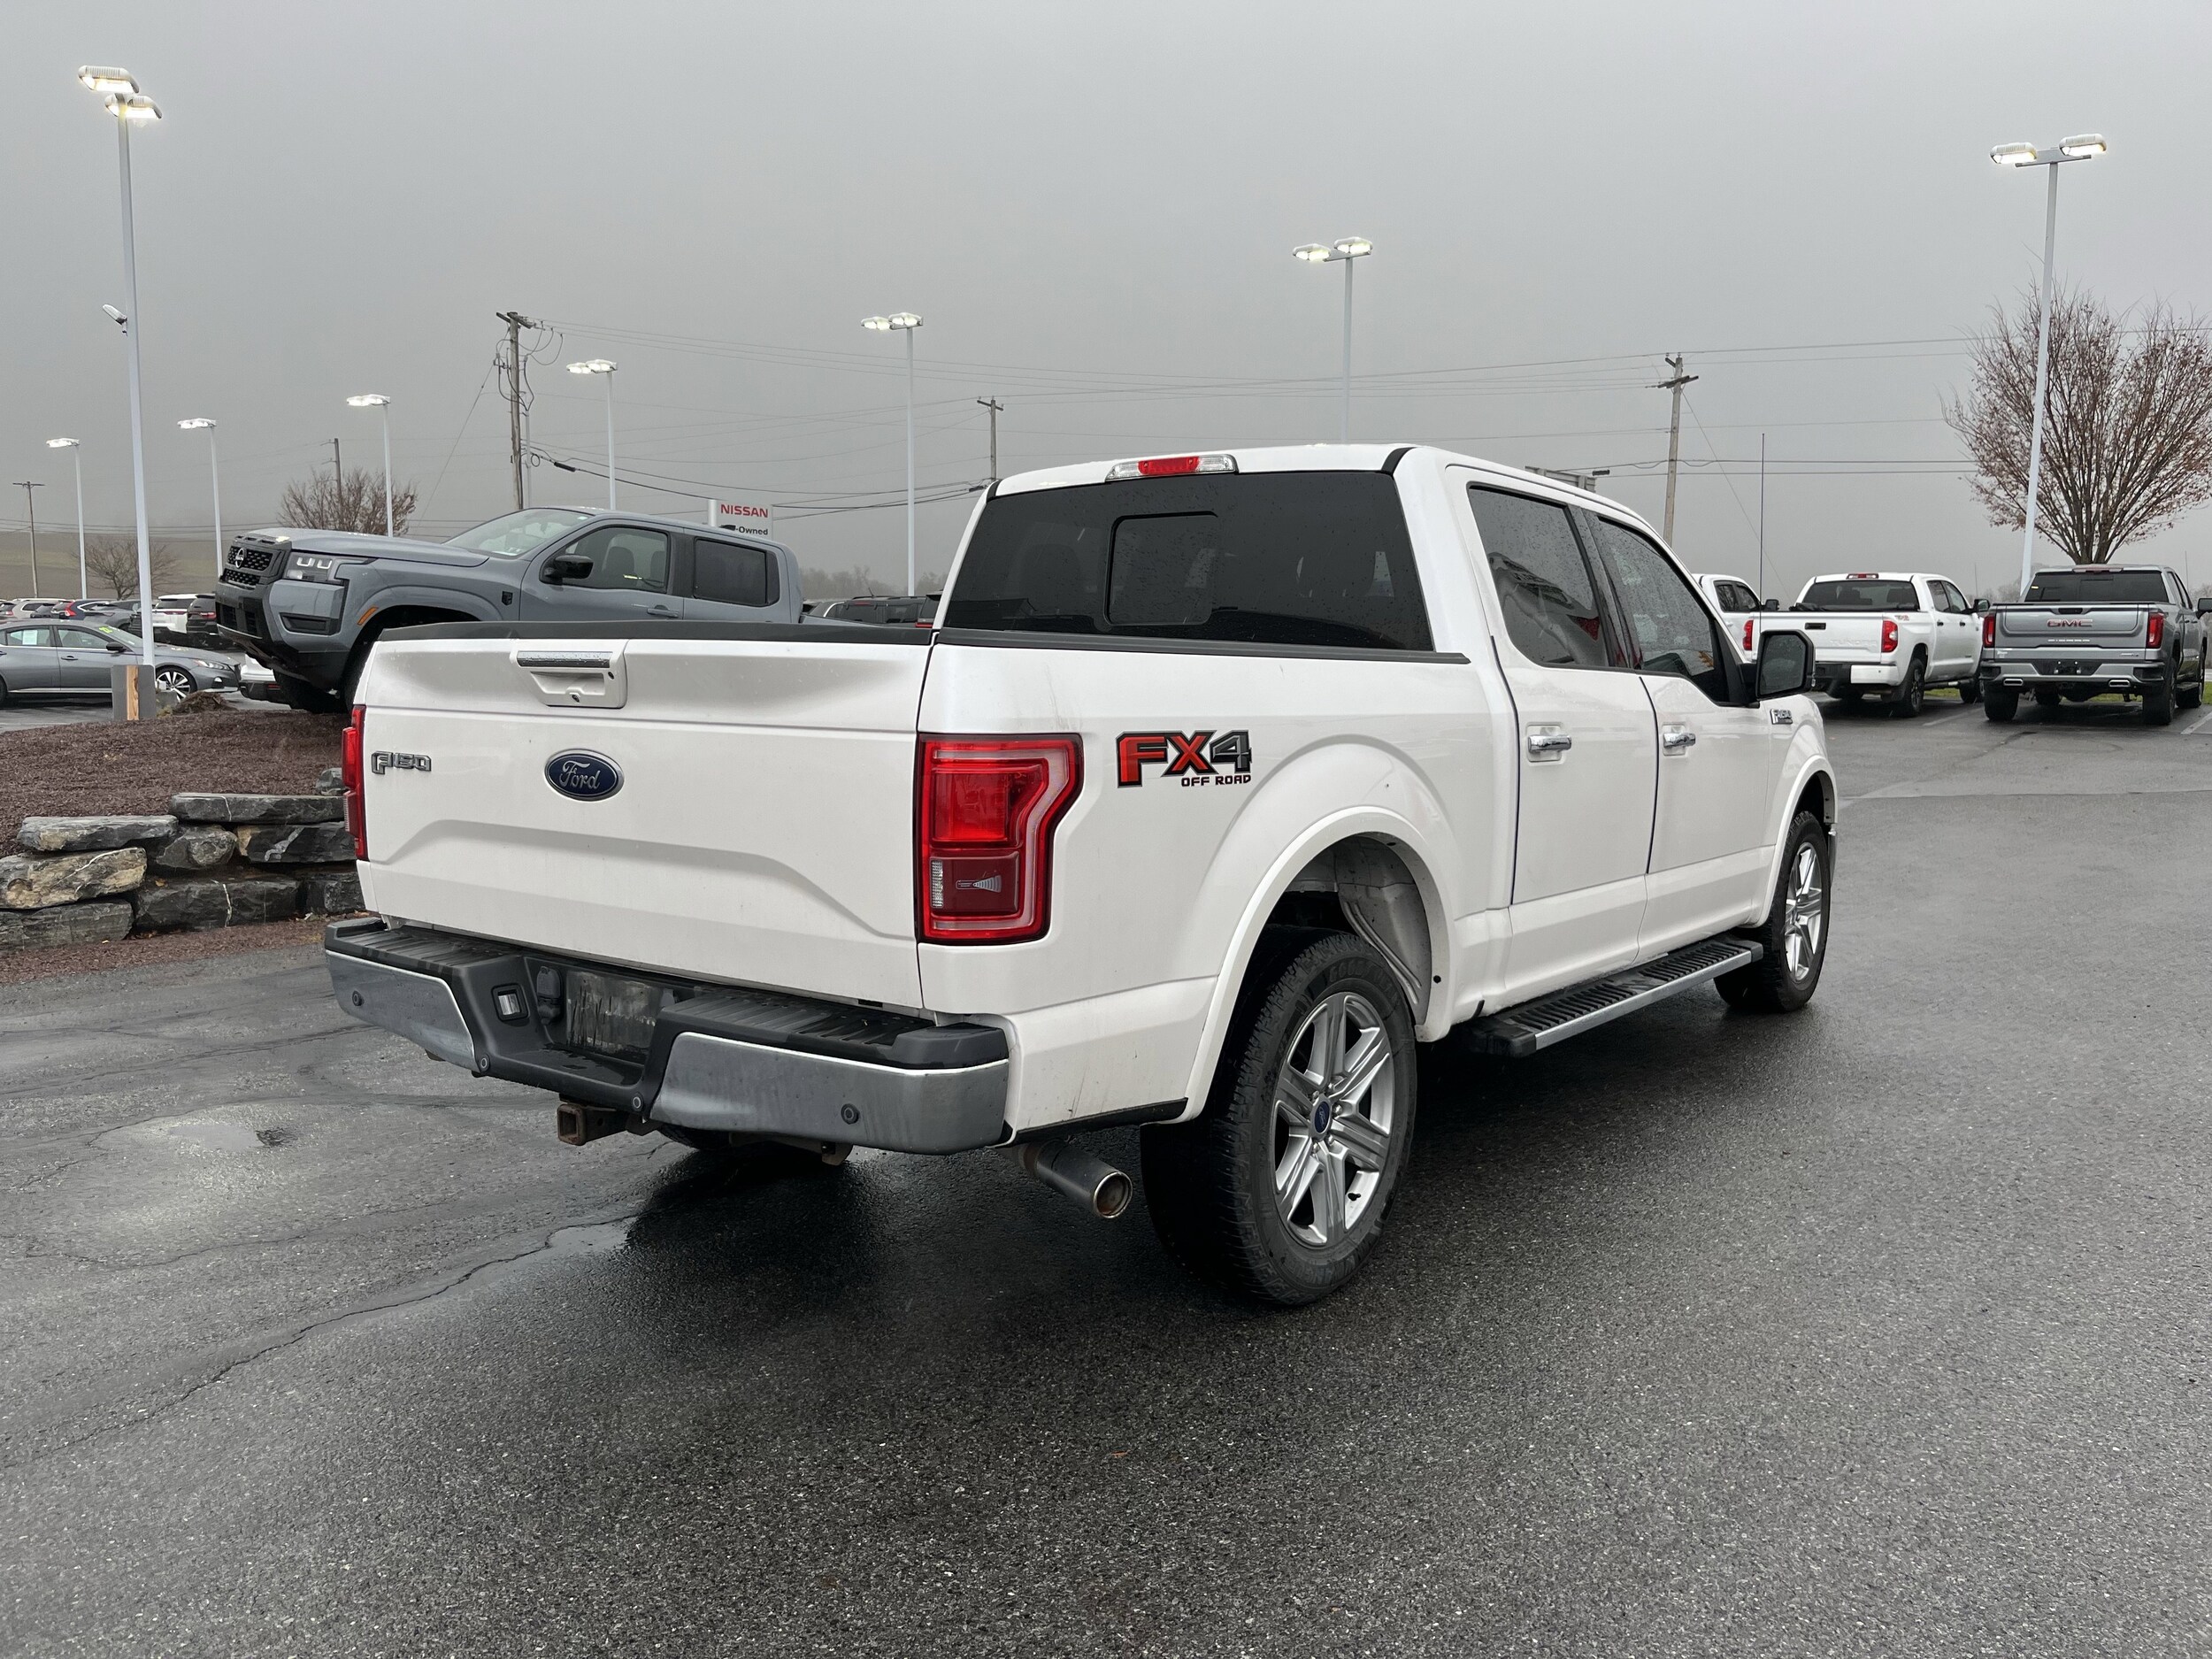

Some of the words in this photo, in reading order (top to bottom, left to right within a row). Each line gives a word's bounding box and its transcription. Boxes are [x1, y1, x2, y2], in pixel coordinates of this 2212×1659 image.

[720, 503, 769, 518] NISSAN
[2047, 618, 2093, 628] GMC
[1116, 730, 1252, 788] FX4
[558, 760, 601, 790] Ford
[1181, 777, 1210, 787] OFF
[1215, 774, 1252, 786] ROAD
